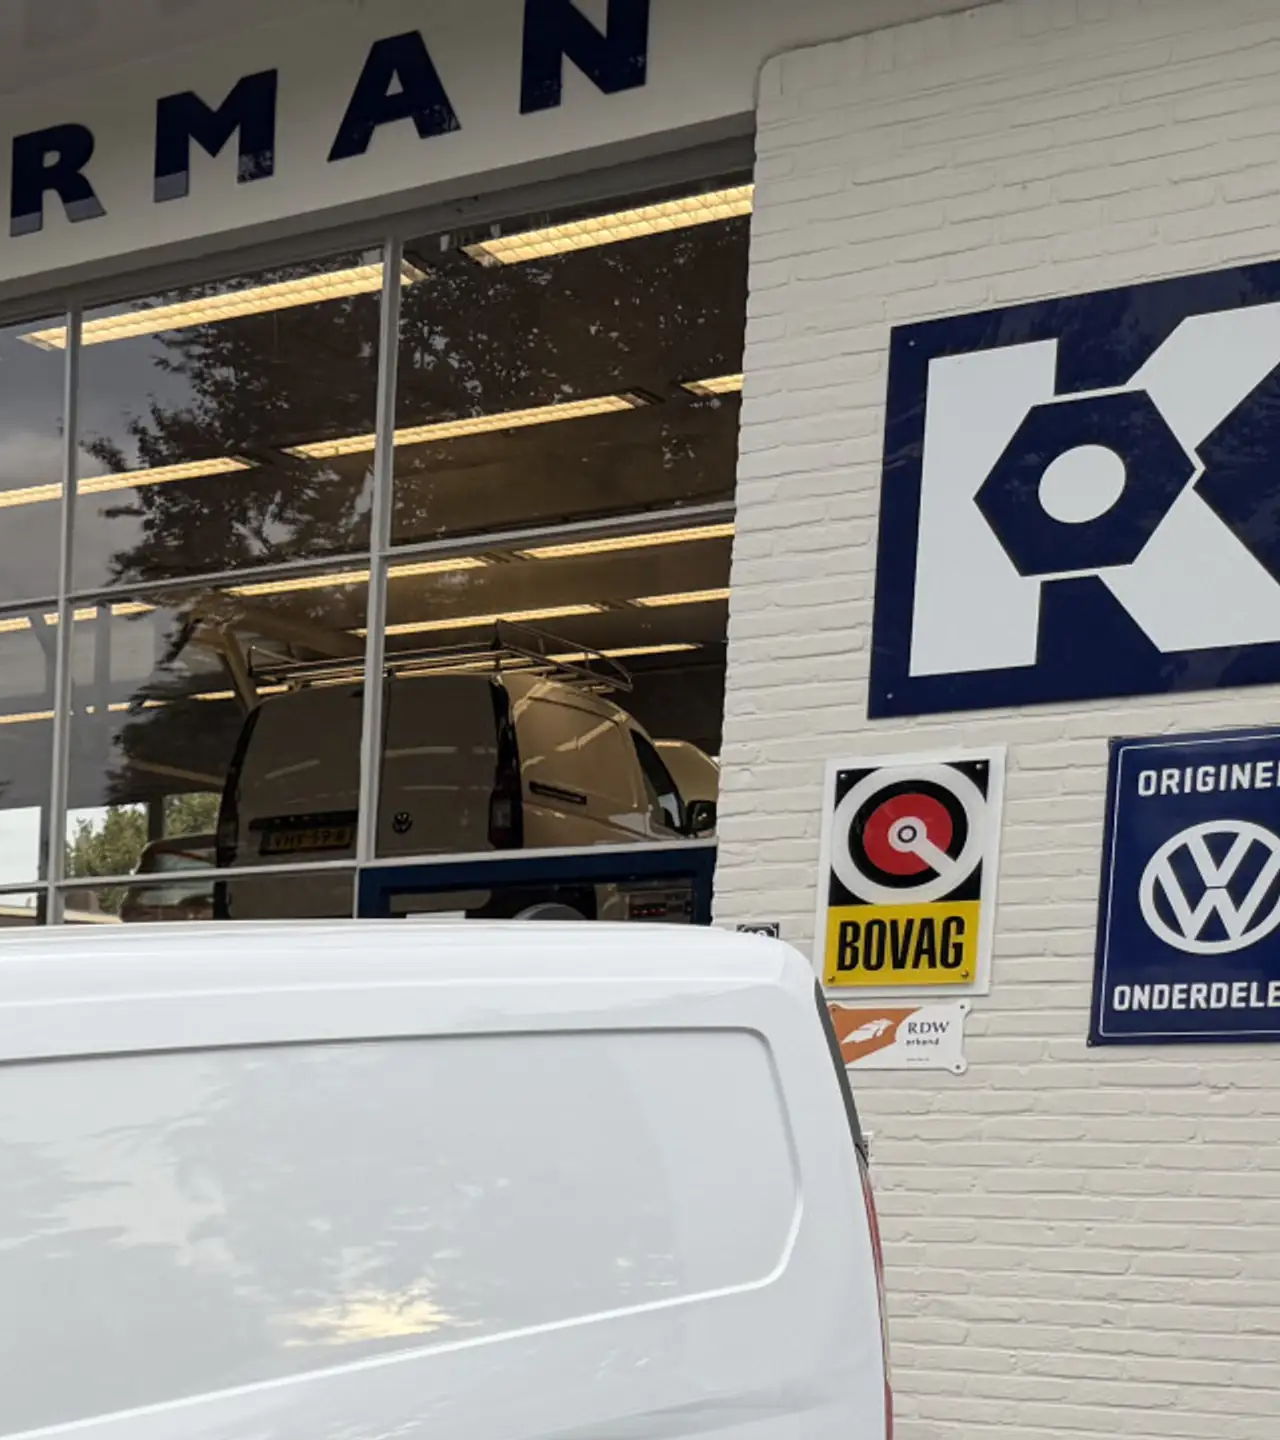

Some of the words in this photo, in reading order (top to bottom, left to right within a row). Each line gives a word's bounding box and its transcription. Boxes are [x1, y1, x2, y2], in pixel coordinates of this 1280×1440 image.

[1137, 760, 1280, 797] ORIGINE
[836, 915, 966, 972] BOVAG
[1112, 980, 1280, 1012] ONDERDELE
[907, 1020, 951, 1036] RDW
